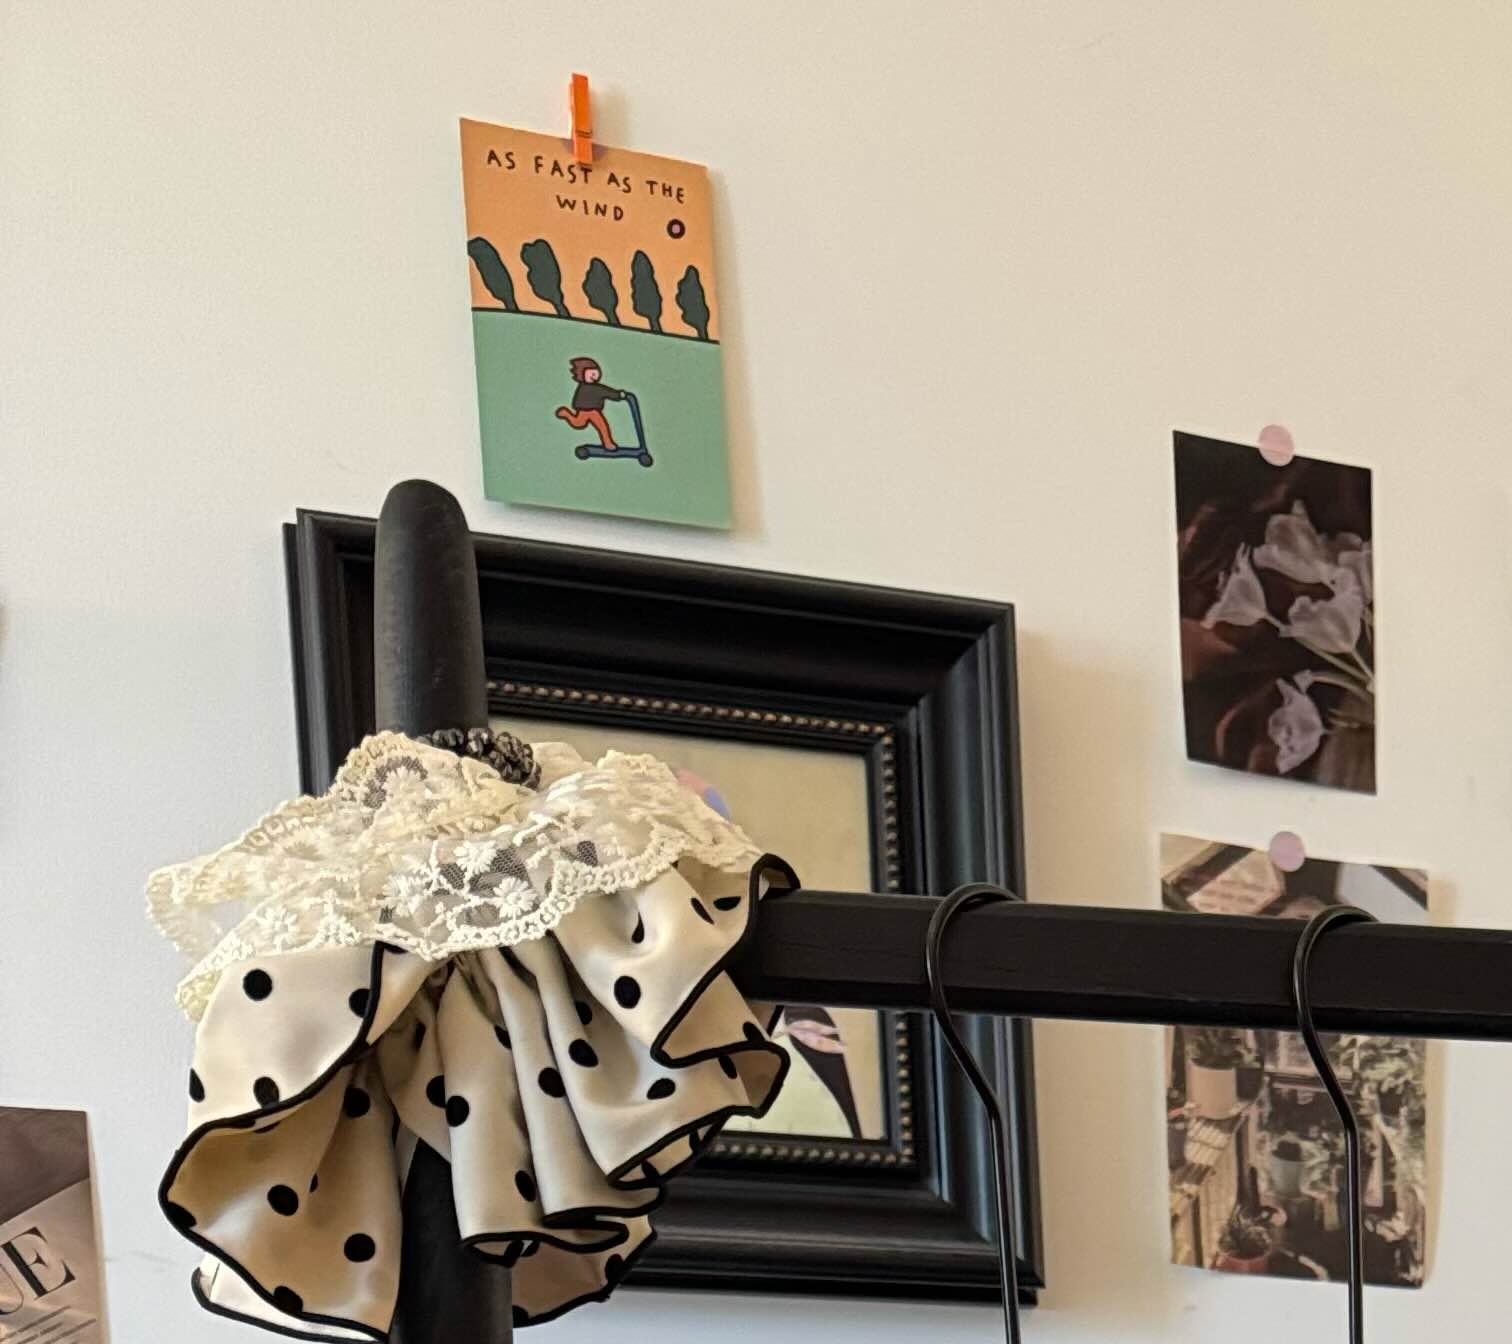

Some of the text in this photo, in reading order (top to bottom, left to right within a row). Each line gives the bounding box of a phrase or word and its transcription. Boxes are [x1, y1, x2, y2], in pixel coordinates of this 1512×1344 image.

[487, 149, 685, 204] AS FAST AS THE
[556, 195, 624, 221] WIND
